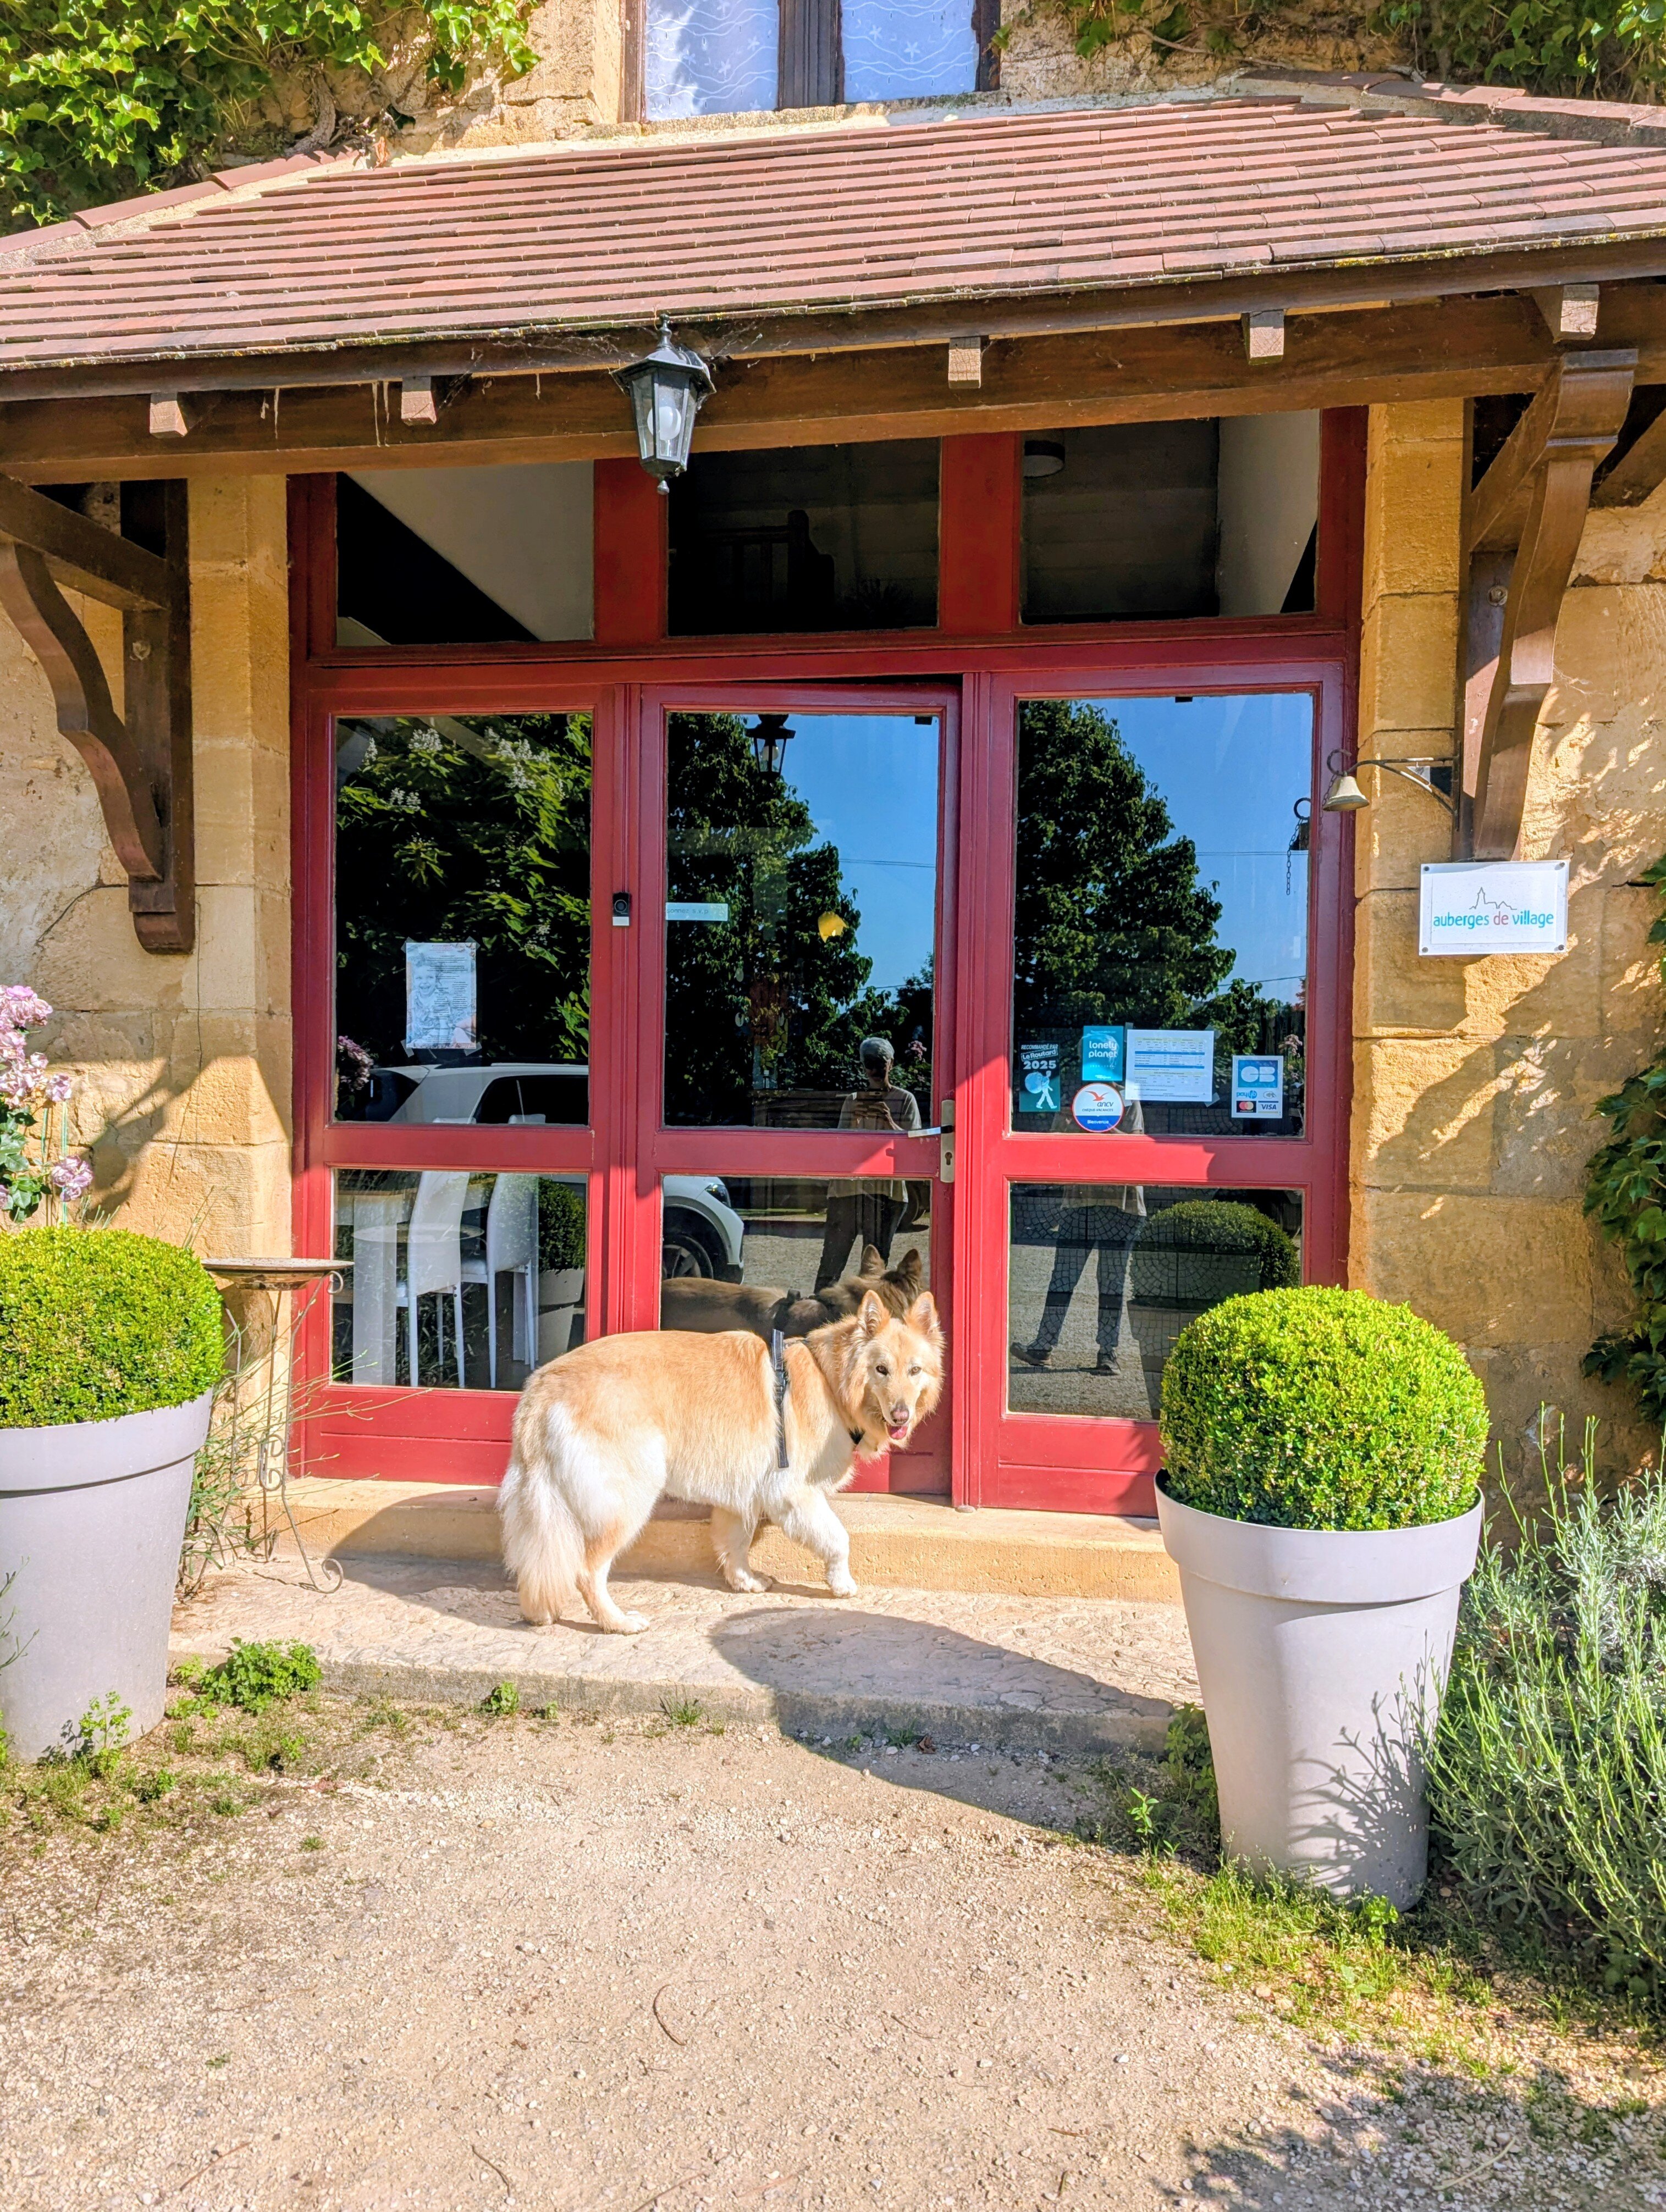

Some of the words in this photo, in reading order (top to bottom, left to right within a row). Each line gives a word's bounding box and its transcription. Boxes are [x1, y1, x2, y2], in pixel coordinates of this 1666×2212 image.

[1433, 912, 1490, 929] auberges
[1493, 911, 1509, 925] de
[1513, 910, 1554, 928] village
[1089, 1041, 1117, 1050] lonely
[1089, 1049, 1117, 1058] planet
[1023, 1060, 1056, 1069] 2025
[1240, 1066, 1275, 1082] CB
